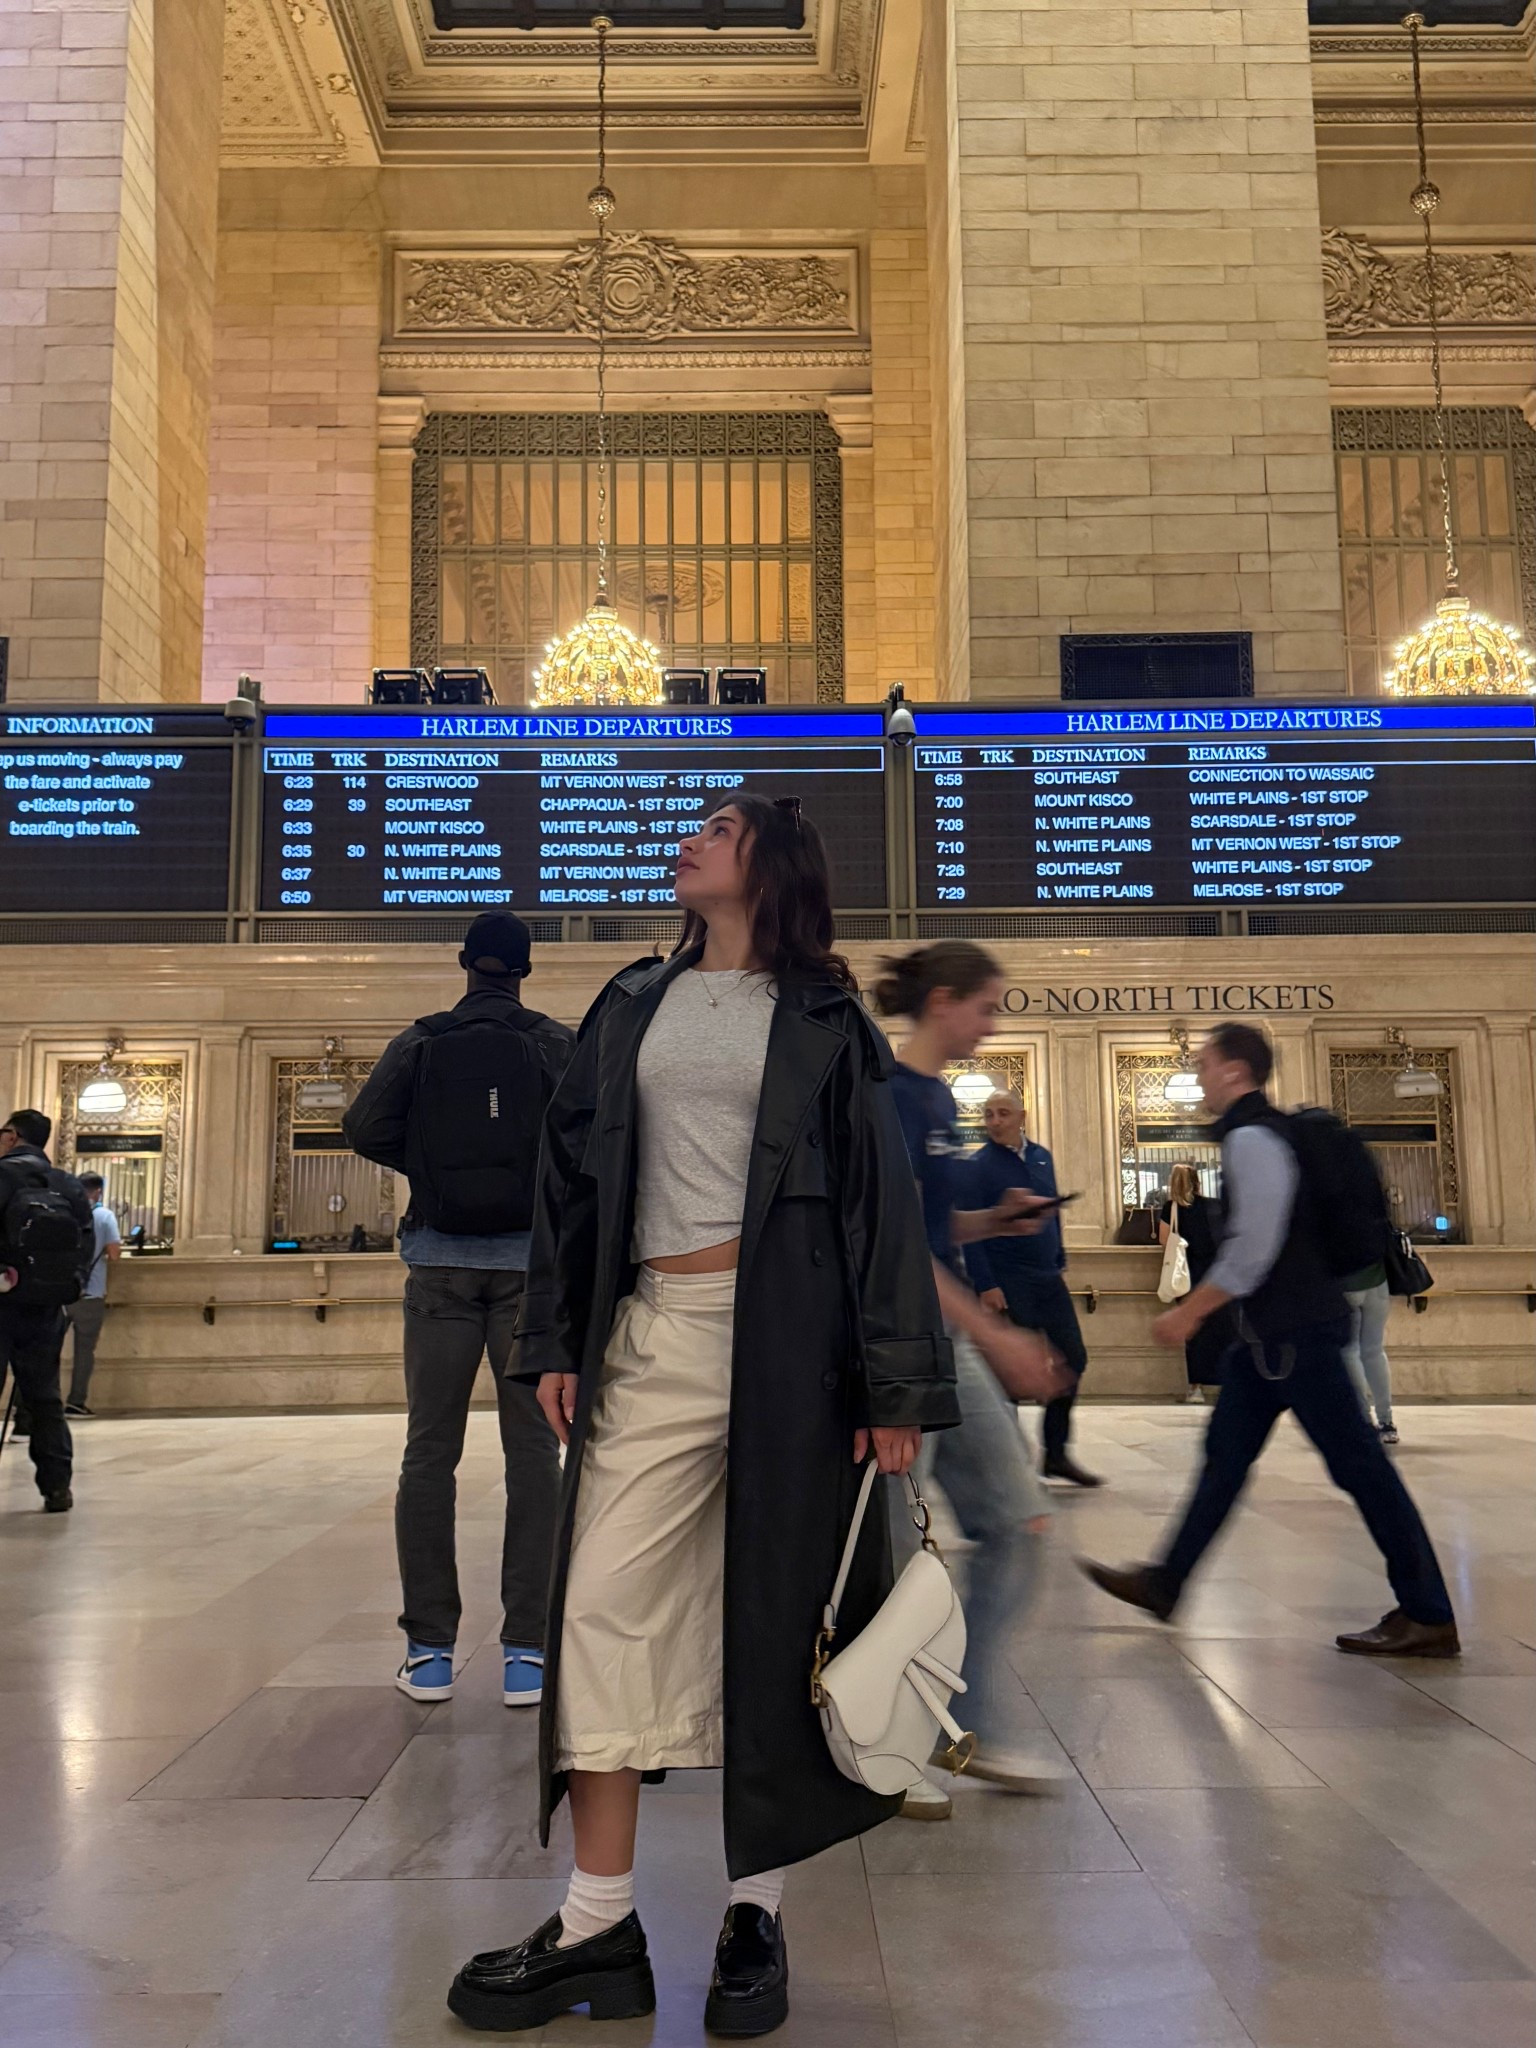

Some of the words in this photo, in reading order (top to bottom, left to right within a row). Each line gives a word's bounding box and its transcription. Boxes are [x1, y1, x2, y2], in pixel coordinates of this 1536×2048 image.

[7, 718, 153, 733] INFORMATION
[422, 719, 518, 736] HARLEM
[524, 719, 578, 736] LINE
[584, 718, 732, 735] DEPARTURES
[1067, 714, 1164, 731] HARLEM
[1169, 713, 1225, 730] LINE
[1231, 710, 1381, 729] DEPARTURES
[16, 755, 35, 766] us
[37, 752, 90, 769] moving
[102, 752, 152, 769] always
[154, 755, 183, 769] pay
[271, 753, 314, 766] TIME
[331, 753, 367, 766] TRK
[385, 753, 499, 767] DESTINATION
[540, 753, 619, 767] REMARKS
[921, 751, 962, 764] TIME
[979, 750, 1014, 763] TRK
[1031, 749, 1146, 762] DESTINATION
[1187, 747, 1266, 760] REMARKS
[4, 775, 29, 789] the
[31, 775, 61, 789] fare
[62, 775, 91, 789] and
[93, 775, 150, 789] activate
[284, 776, 313, 788] 6:23
[343, 776, 366, 788] 114
[386, 776, 479, 788] CRESTWOOD
[541, 776, 562, 788] MT
[564, 776, 623, 788] VERNON
[626, 776, 667, 788] WEST
[678, 775, 704, 788] 1ST
[706, 775, 743, 788] STOP
[935, 774, 962, 785] 6:58
[1034, 771, 1119, 784] SOUTHEAST
[1188, 769, 1283, 782] CONNECTION
[1286, 768, 1306, 780] TO
[1309, 767, 1374, 780] WASSAIC
[18, 798, 80, 812] e-tickets
[82, 798, 117, 815] prior
[118, 798, 134, 812] to
[284, 799, 313, 811] 6:29
[348, 799, 366, 811] 39
[385, 798, 472, 811] SOUTHEAST
[541, 798, 627, 811] CHAPPAQUA
[638, 798, 664, 811] 1ST
[666, 798, 704, 810] STOP
[936, 796, 963, 808] 7:00
[1035, 794, 1086, 807] MOUNT
[1089, 794, 1133, 806] KISCO
[1190, 792, 1236, 804] WHITE
[1239, 792, 1289, 804] PLAINS
[1301, 791, 1327, 803] 1ST
[1330, 790, 1368, 803] STOP
[10, 821, 74, 838] boarding
[76, 821, 101, 835] the
[102, 821, 140, 835] train.
[283, 822, 312, 834] 6:33
[385, 821, 438, 834] MOUNT
[440, 821, 484, 834] KISCO
[540, 821, 586, 833] WHITE
[588, 821, 638, 833] PLAINS
[649, 821, 675, 833] 1ST
[677, 820, 702, 833] STO
[936, 819, 963, 831] 7:08
[1036, 818, 1049, 829] N.
[1052, 817, 1098, 829] WHITE
[1101, 816, 1151, 829] PLAINS
[1191, 815, 1276, 828] SCARSDALE
[1288, 814, 1314, 826] 1ST
[1317, 813, 1356, 826] STOP
[282, 845, 312, 857] 6:35
[347, 845, 365, 857] 30
[385, 844, 399, 856] N.
[402, 844, 448, 856] WHITE
[451, 844, 501, 857] PLAINS
[540, 844, 625, 856] SCARSDALE
[636, 844, 662, 856] 1ST
[664, 844, 681, 856] ST
[936, 842, 964, 853] 7:10
[1036, 840, 1050, 852] N.
[1053, 840, 1098, 852] WHITE
[1102, 839, 1151, 851] PLAINS
[1192, 838, 1213, 850] MT
[1215, 838, 1276, 850] VERNON
[1279, 837, 1321, 849] WEST
[1333, 836, 1359, 849] 1ST
[1362, 836, 1401, 849] STOP
[282, 868, 311, 880] 6:37
[385, 868, 399, 879] N.
[402, 867, 448, 879] WHITE
[451, 867, 501, 880] PLAINS
[540, 867, 562, 879] MT
[564, 866, 624, 879] VERNON
[626, 866, 667, 879] WEST
[937, 864, 964, 876] 7:26
[1037, 862, 1122, 875] SOUTHEAST
[1192, 861, 1239, 873] WHITE
[1242, 861, 1293, 873] PLAINS
[1304, 860, 1331, 872] 1ST
[1333, 859, 1372, 872] STOP
[281, 891, 311, 903] 6:50
[384, 890, 408, 902] MT
[407, 890, 468, 903] VERNON
[471, 890, 513, 903] WEST
[540, 889, 609, 902] MELROSE
[620, 889, 646, 902] 1ST
[648, 890, 676, 902] STO
[937, 887, 965, 899] 7:29
[1038, 886, 1051, 898] N.
[1054, 886, 1100, 898] WHITE
[1103, 885, 1153, 897] PLAINS
[1194, 884, 1263, 896] MELROSE
[1275, 883, 1302, 896] 1ST
[1304, 883, 1343, 896] STOP
[999, 985, 1175, 1013] O-NORTH
[1186, 985, 1334, 1011] TICKETS
[489, 1087, 499, 1118] THULE
